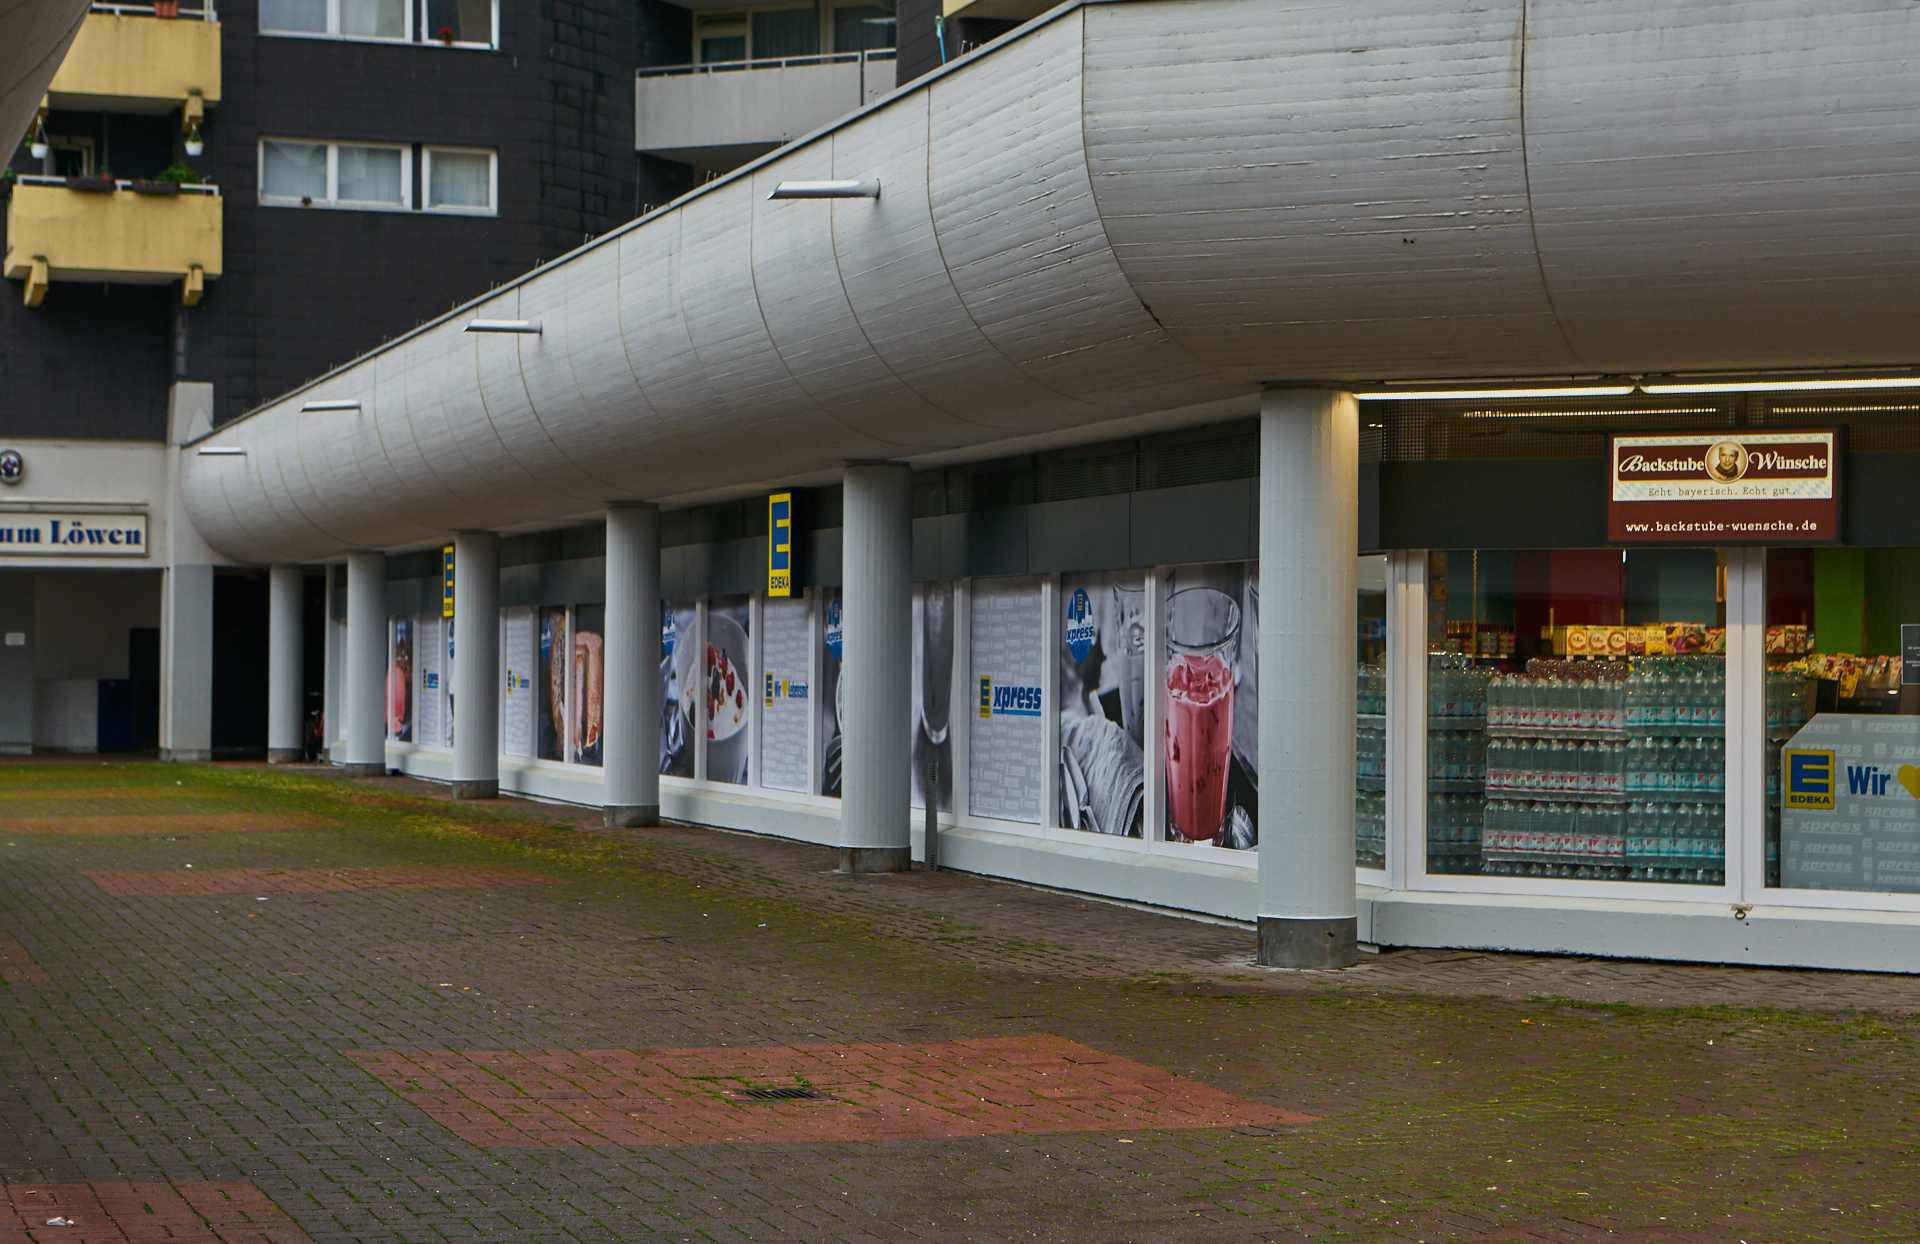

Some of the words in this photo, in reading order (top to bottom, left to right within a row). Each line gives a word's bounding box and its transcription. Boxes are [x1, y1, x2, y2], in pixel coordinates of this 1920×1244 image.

[1619, 454, 1705, 472] Backstube
[1748, 450, 1827, 471] Wünsche
[1648, 487, 1672, 496] Echt
[1678, 486, 1738, 498] bayerisch.
[1742, 486, 1767, 496] Echt
[1772, 486, 1796, 497] gut.
[50, 520, 142, 545] Löwen
[1625, 519, 1818, 532] www.backstube-wuensche.de
[771, 501, 789, 570] E
[771, 576, 790, 589] EDEKA
[1066, 625, 1094, 641] xpress
[993, 686, 1042, 714] xpress
[1791, 755, 1829, 793] E
[1847, 766, 1890, 795] Wir
[1790, 795, 1830, 804] EDEKA
